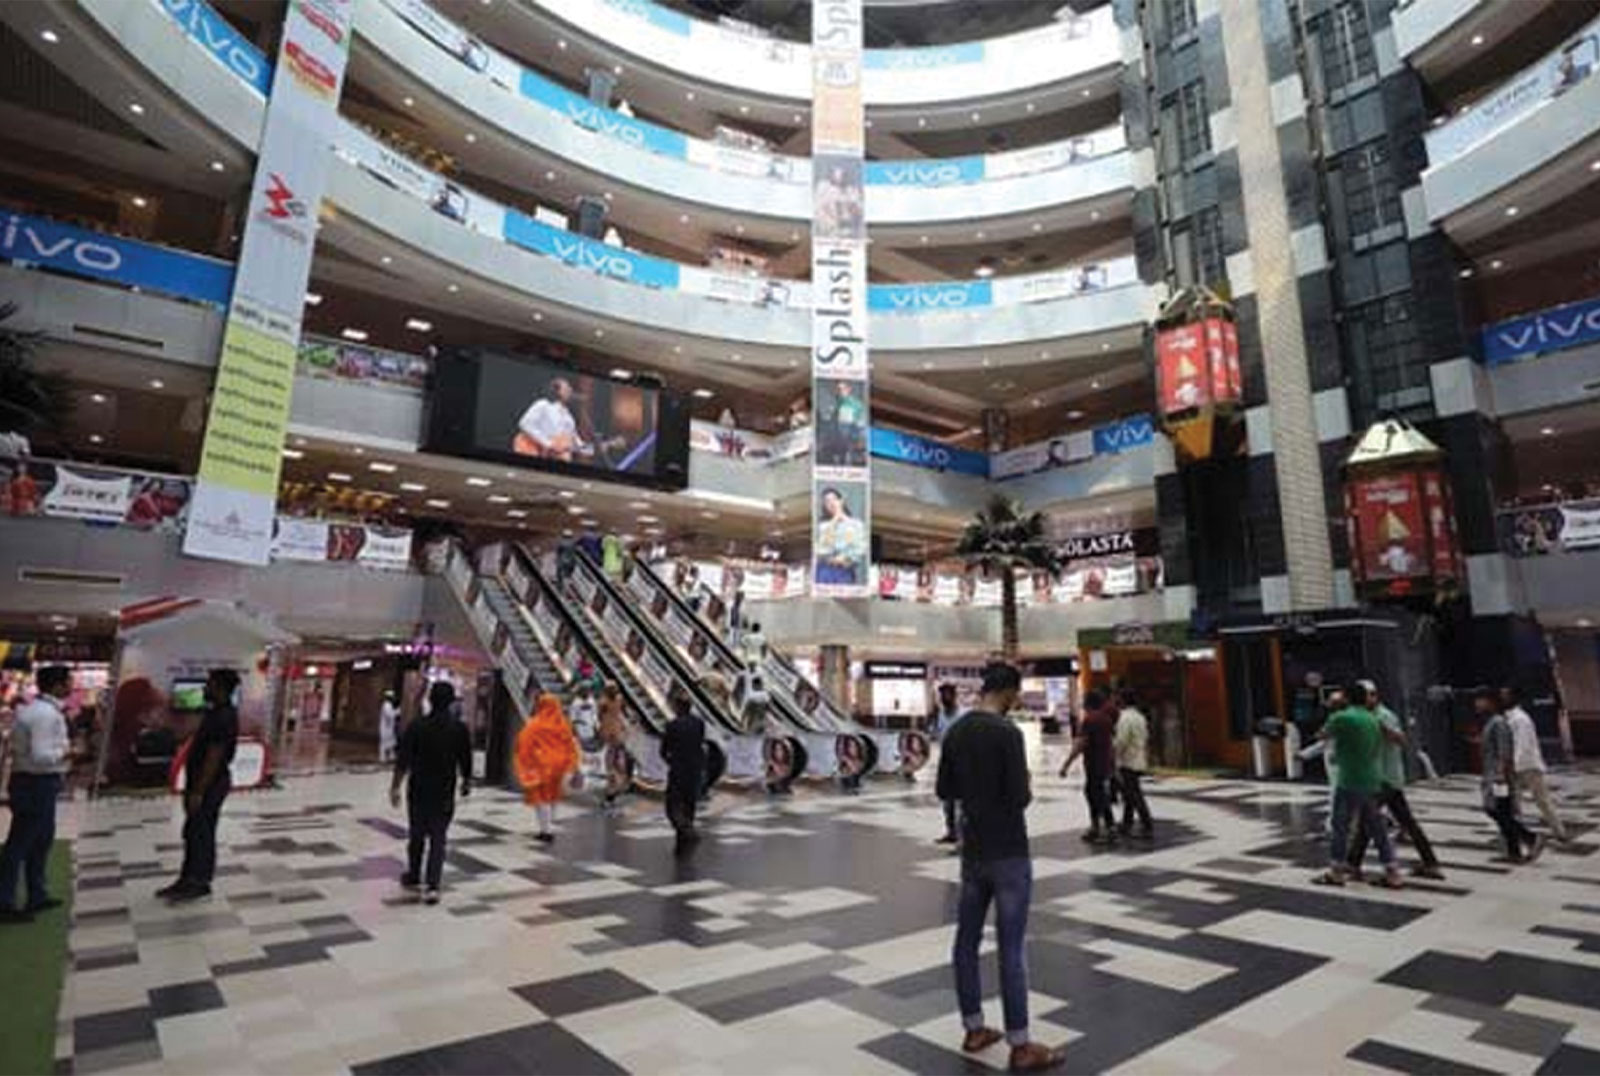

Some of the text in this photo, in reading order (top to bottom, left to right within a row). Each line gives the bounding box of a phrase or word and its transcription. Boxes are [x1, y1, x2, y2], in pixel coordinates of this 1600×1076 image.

[567, 101, 645, 143] vivo
[883, 163, 961, 185] vivo
[0, 215, 121, 271] ivo
[552, 236, 633, 276] vivo
[815, 248, 864, 366] Splash
[889, 286, 968, 306] vivo
[897, 438, 951, 463] vivo
